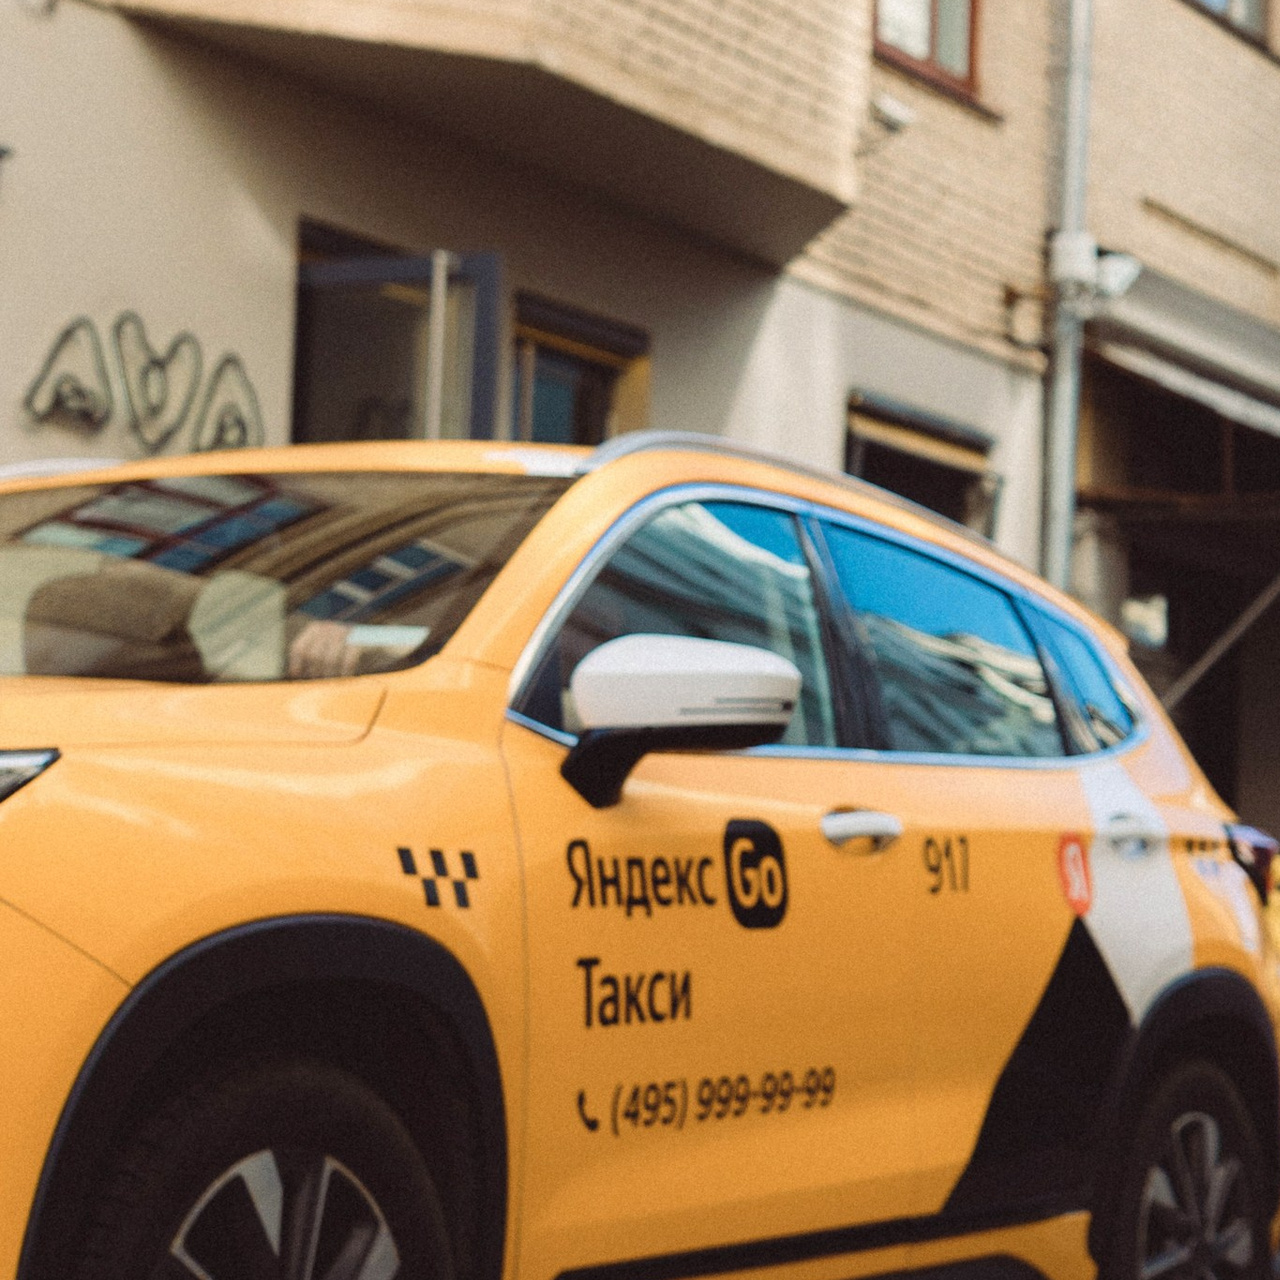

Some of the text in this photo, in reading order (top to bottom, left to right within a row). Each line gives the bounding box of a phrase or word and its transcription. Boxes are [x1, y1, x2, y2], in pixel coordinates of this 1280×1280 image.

[566, 837, 783, 918] Яндекс Go
[922, 835, 970, 895] 911
[576, 956, 692, 1029] Такси
[611, 1066, 836, 1135] (495) 999-99-99
